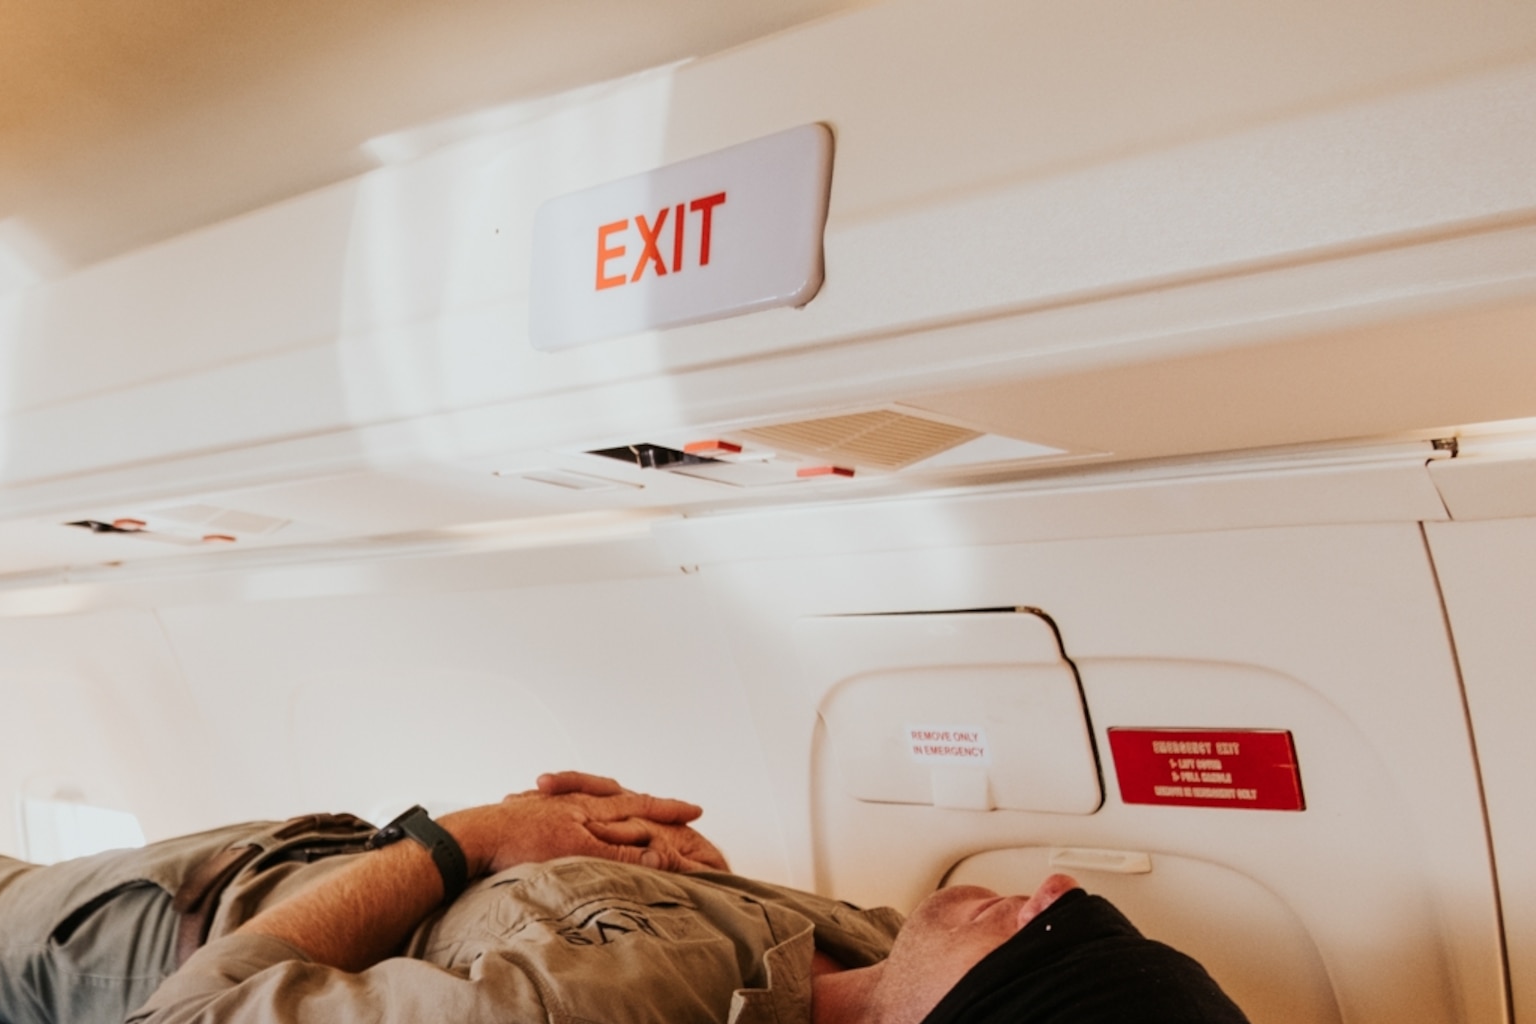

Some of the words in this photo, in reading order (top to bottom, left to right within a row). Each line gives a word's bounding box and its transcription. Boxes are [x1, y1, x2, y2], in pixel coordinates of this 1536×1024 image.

[595, 191, 727, 292] EXIT
[911, 731, 951, 742] REMOVE
[952, 731, 978, 743] ONLY
[912, 745, 923, 755] IN
[924, 745, 984, 757] EMERGENCY
